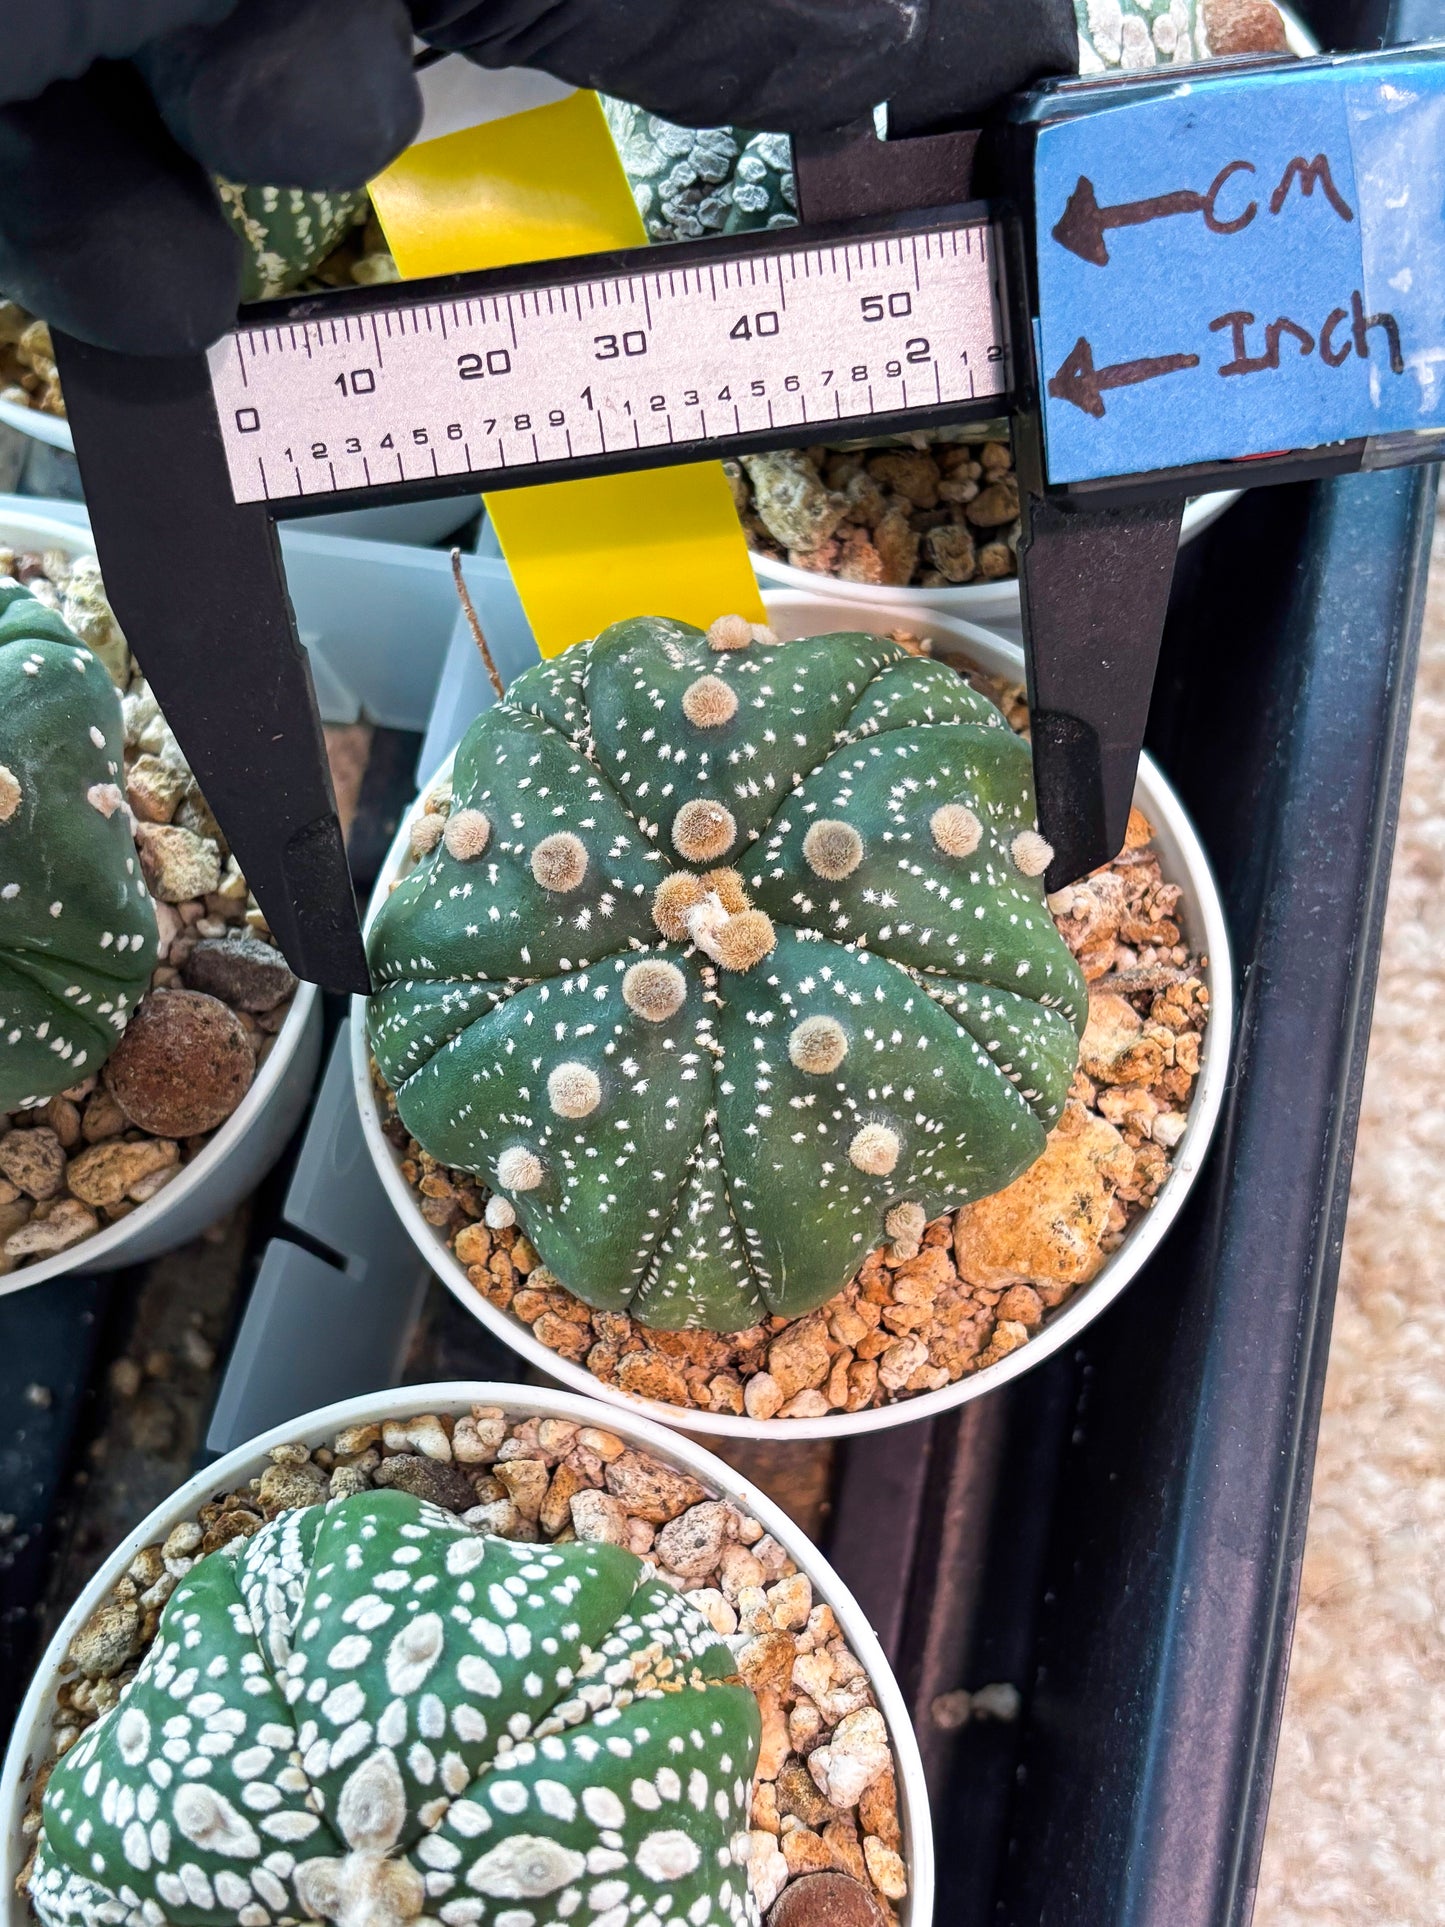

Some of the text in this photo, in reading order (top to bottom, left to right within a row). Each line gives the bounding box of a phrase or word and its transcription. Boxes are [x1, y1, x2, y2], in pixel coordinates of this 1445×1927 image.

[235, 292, 913, 434] 0 10 20 30 40 50
[1209, 290, 1405, 376] Inch
[283, 447, 295, 463] 1
[310, 441, 330, 460] 2
[344, 437, 363, 454] 3
[379, 432, 395, 450] 4
[411, 427, 430, 446] 5
[446, 422, 464, 441] 6
[482, 417, 498, 436] 7
[513, 413, 532, 432] 8
[548, 409, 566, 428] 9
[579, 385, 594, 412] 1
[622, 399, 632, 417] 1
[649, 394, 667, 413] 2
[683, 389, 700, 407] 3
[717, 384, 732, 402] 4
[750, 379, 767, 398] 5
[783, 374, 801, 393] 6
[820, 369, 835, 387] 7
[850, 364, 869, 383] 8
[884, 359, 902, 379] 9
[905, 337, 932, 365] 2
[959, 350, 968, 366] 1
